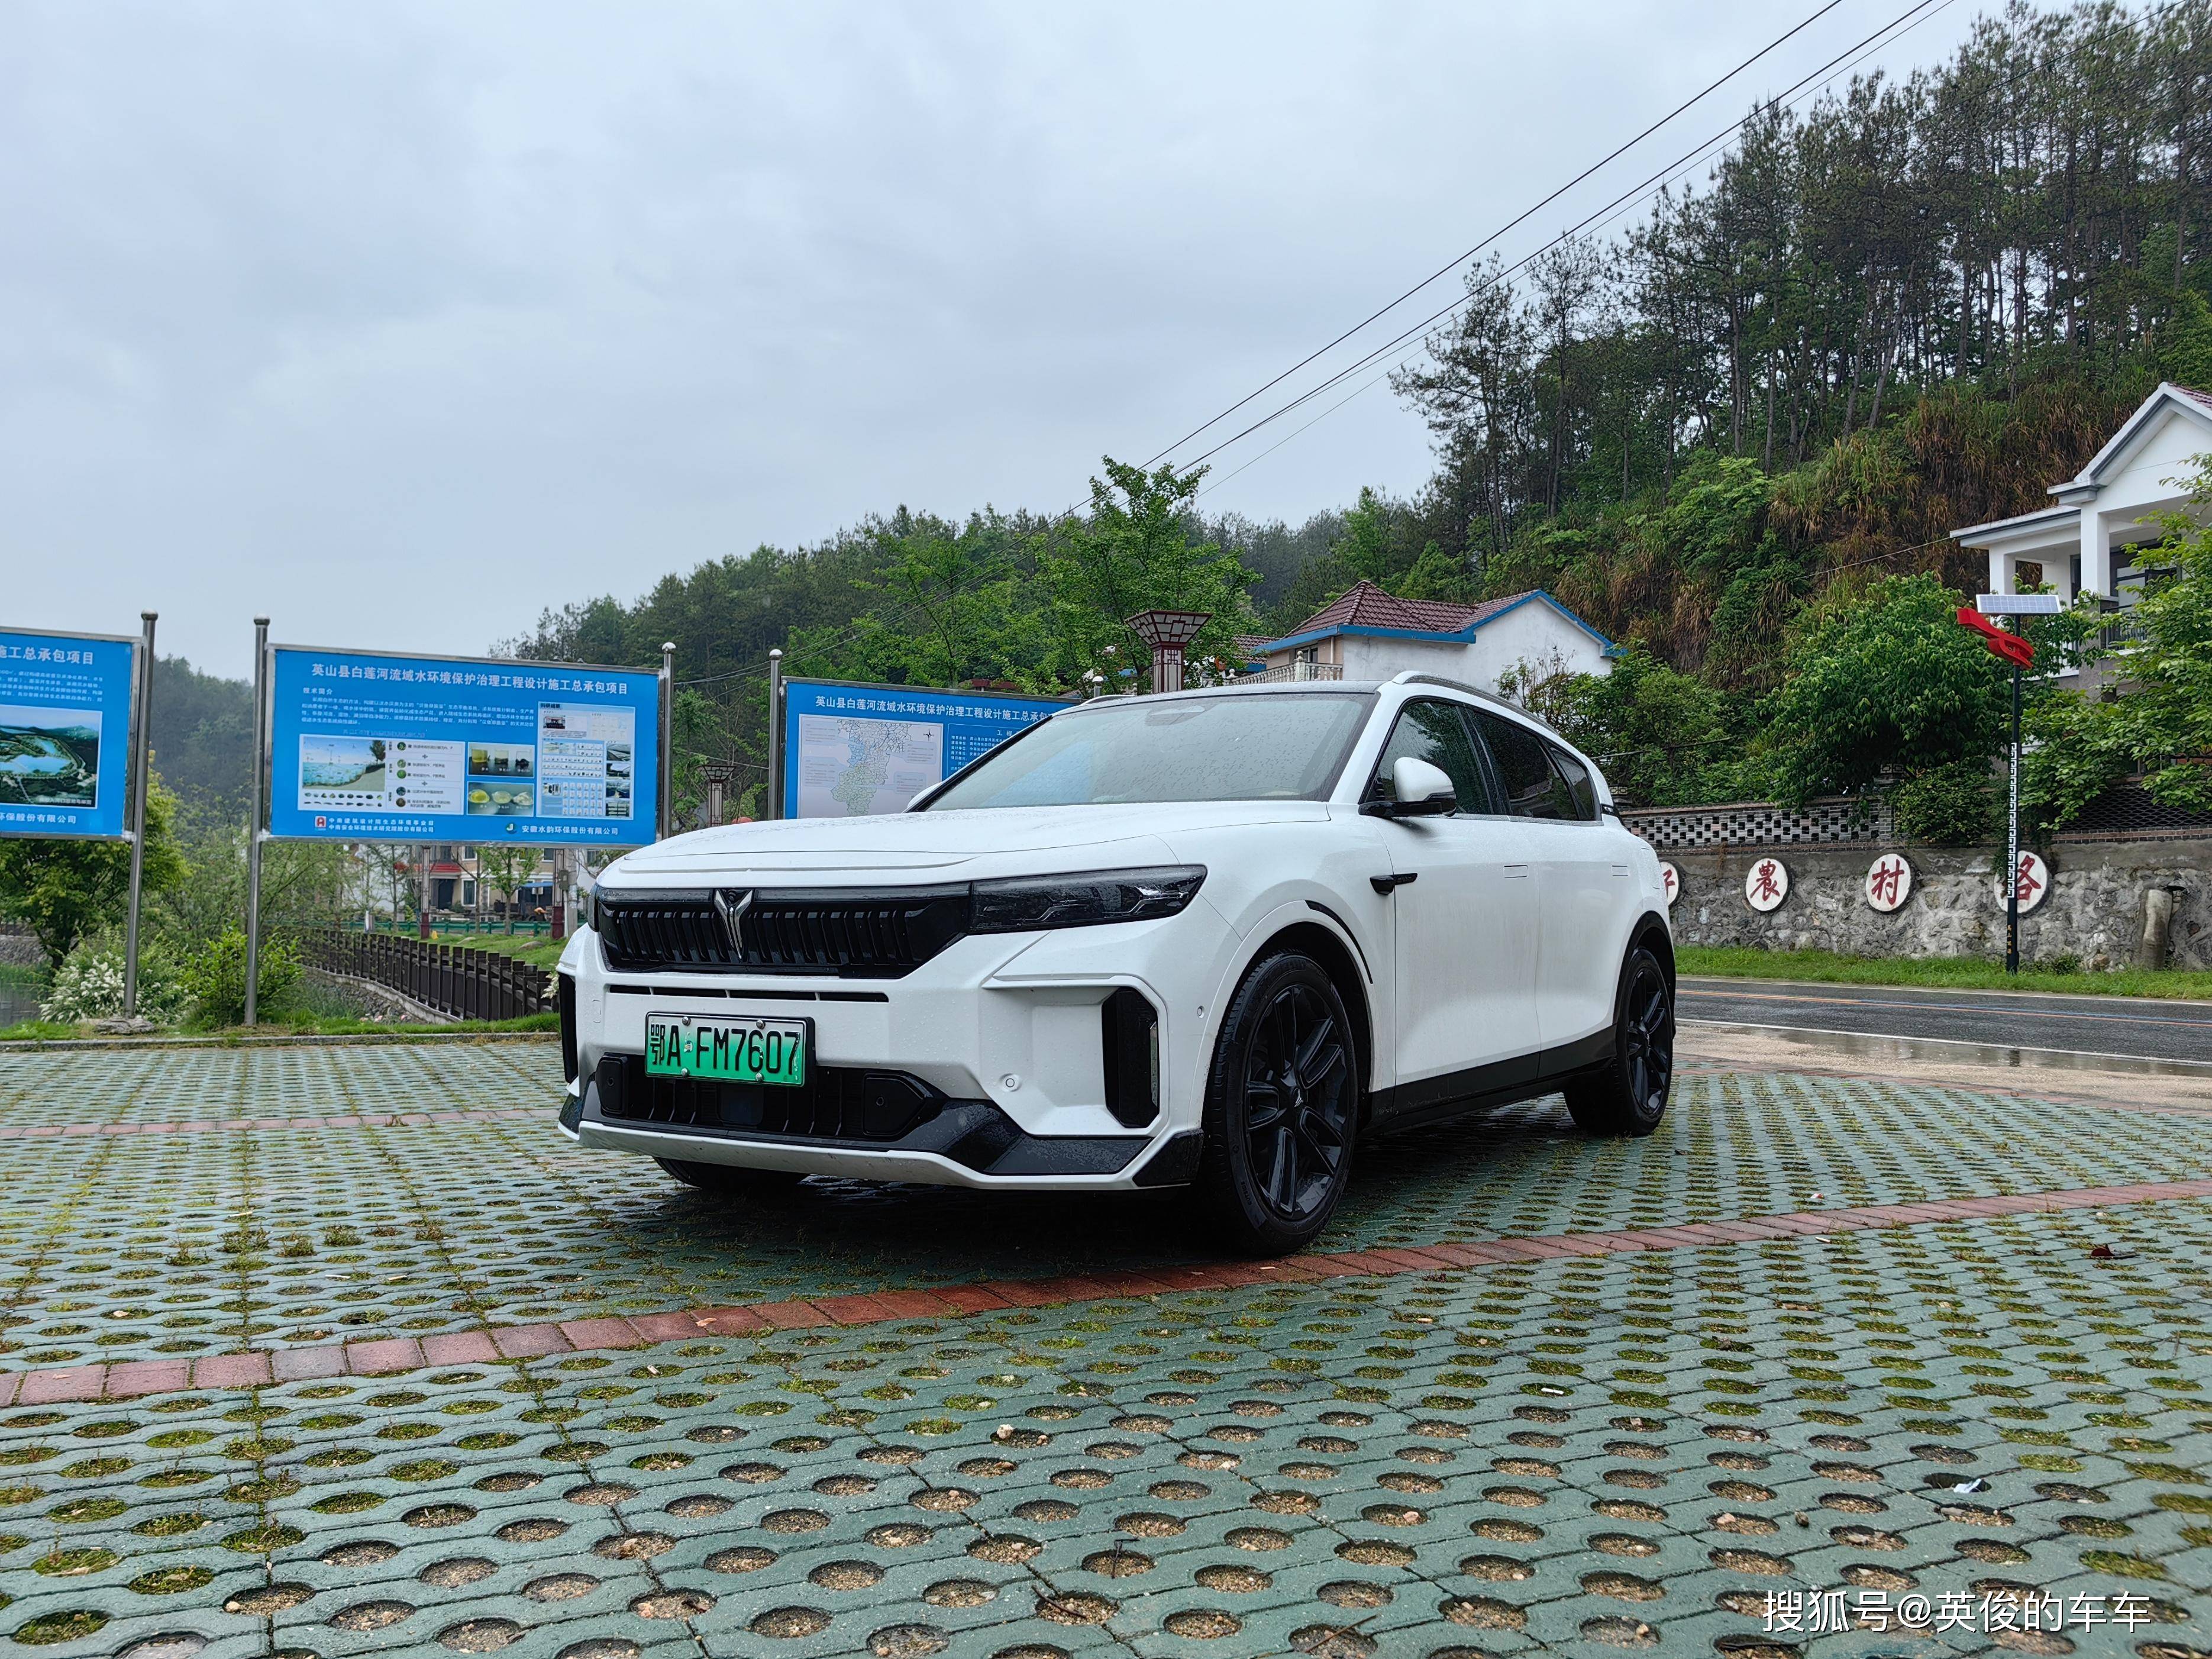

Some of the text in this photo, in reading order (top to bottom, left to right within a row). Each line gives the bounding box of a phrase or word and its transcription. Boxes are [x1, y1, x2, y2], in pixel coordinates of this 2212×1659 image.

[311, 663, 628, 695] 英山县白莲河流域水环境保护治理工程设计施工总承包项目
[696, 1026, 800, 1075] FM7607
